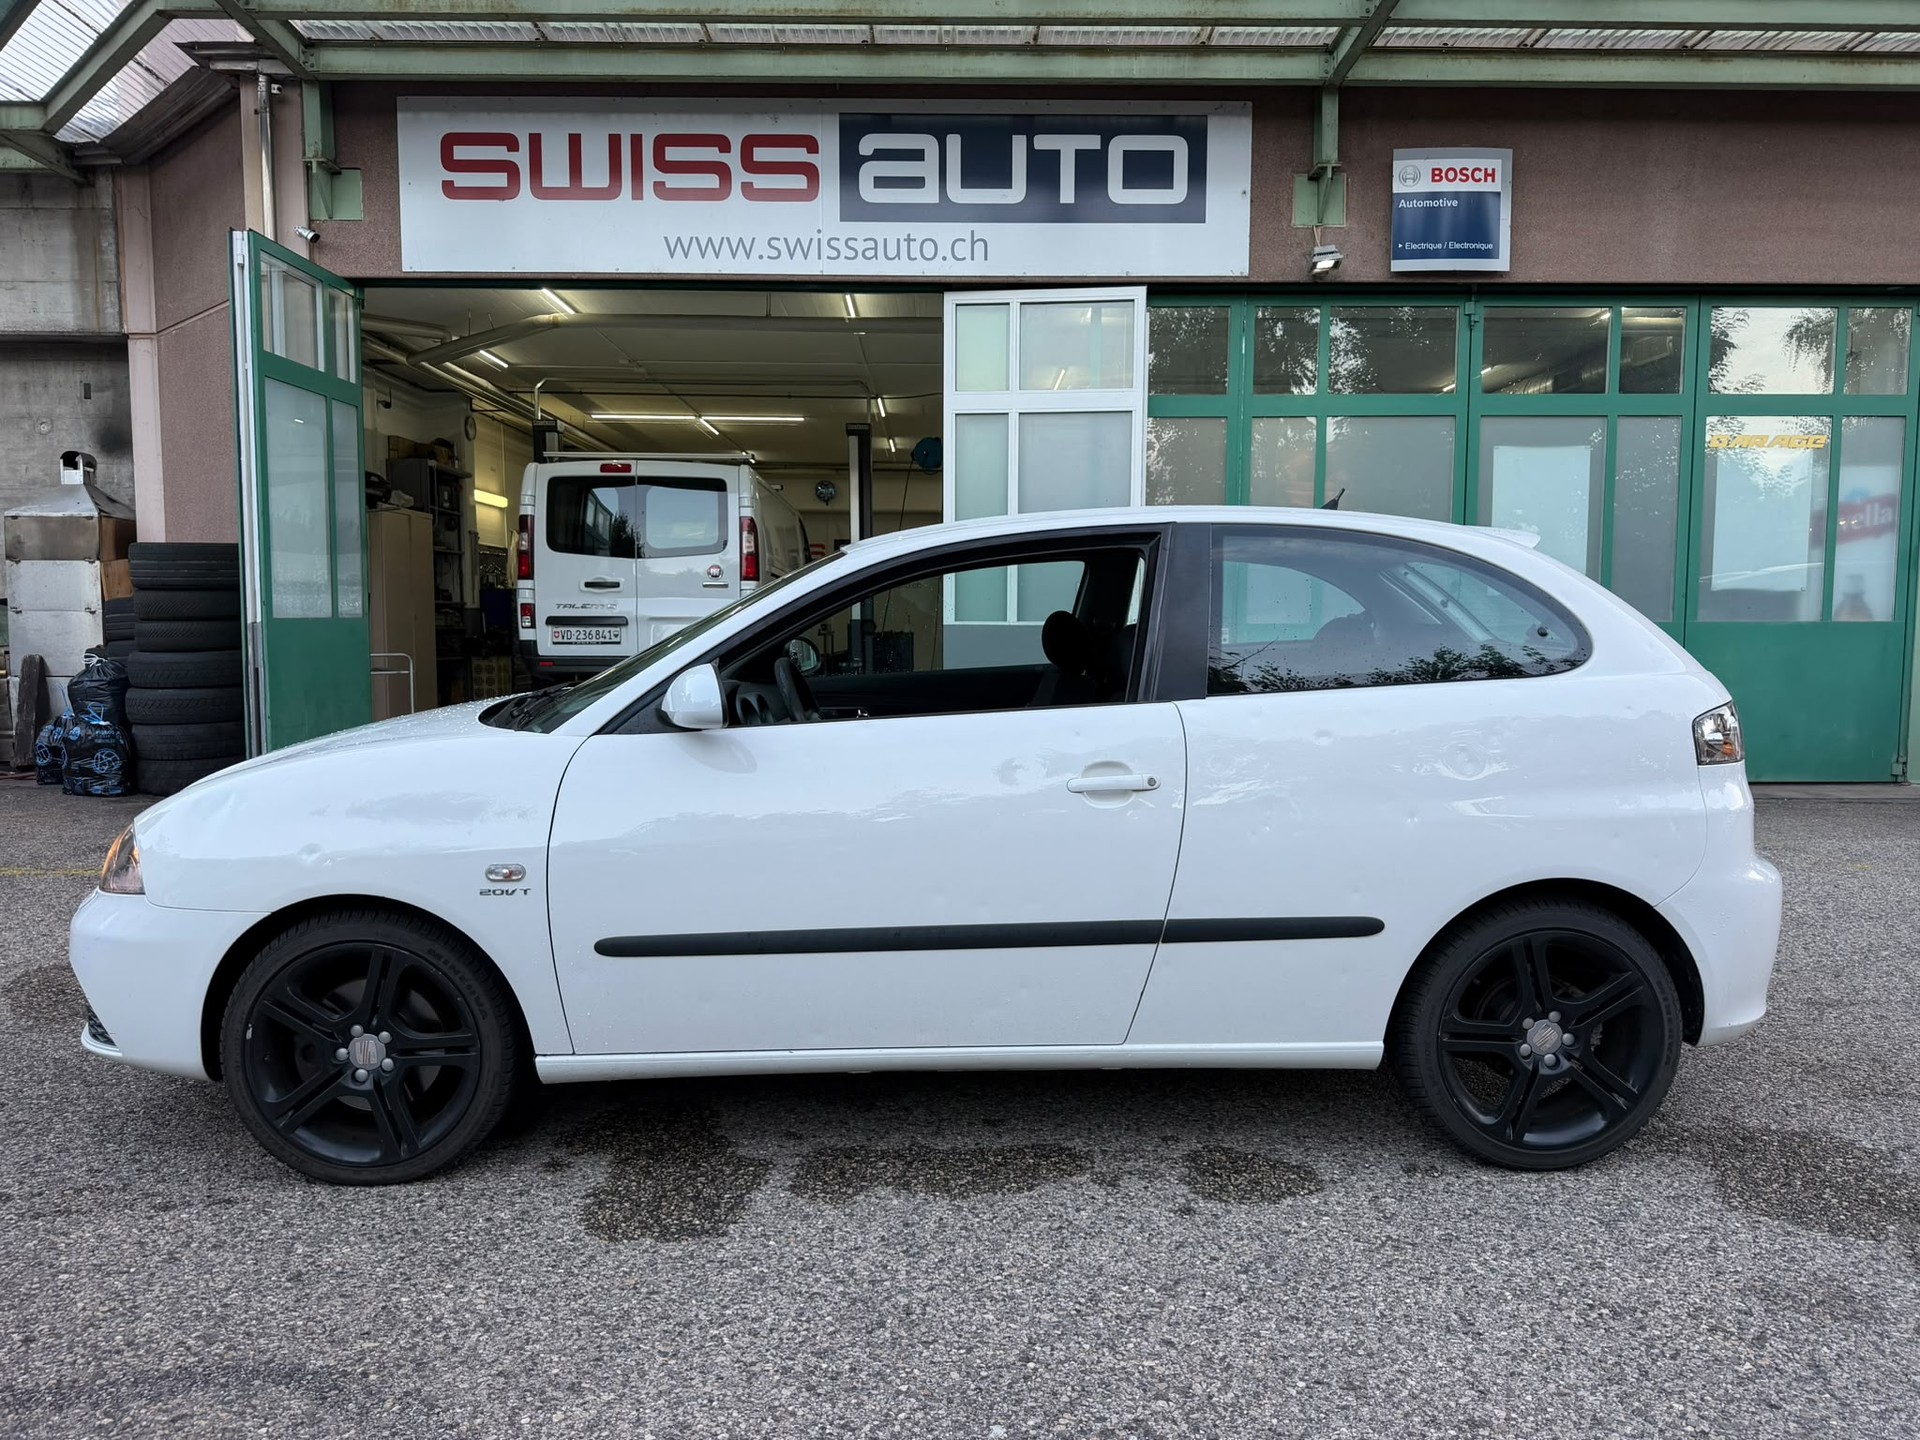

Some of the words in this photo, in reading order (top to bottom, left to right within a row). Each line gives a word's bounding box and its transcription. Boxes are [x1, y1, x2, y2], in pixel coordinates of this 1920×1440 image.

[440, 132, 820, 202] SWISS
[1430, 167, 1496, 183] BOSCH
[1398, 198, 1459, 208] Automotive
[663, 229, 990, 262] www.swissauto.ch
[1405, 242, 1442, 250] Electrique
[1448, 241, 1494, 250] Electronique
